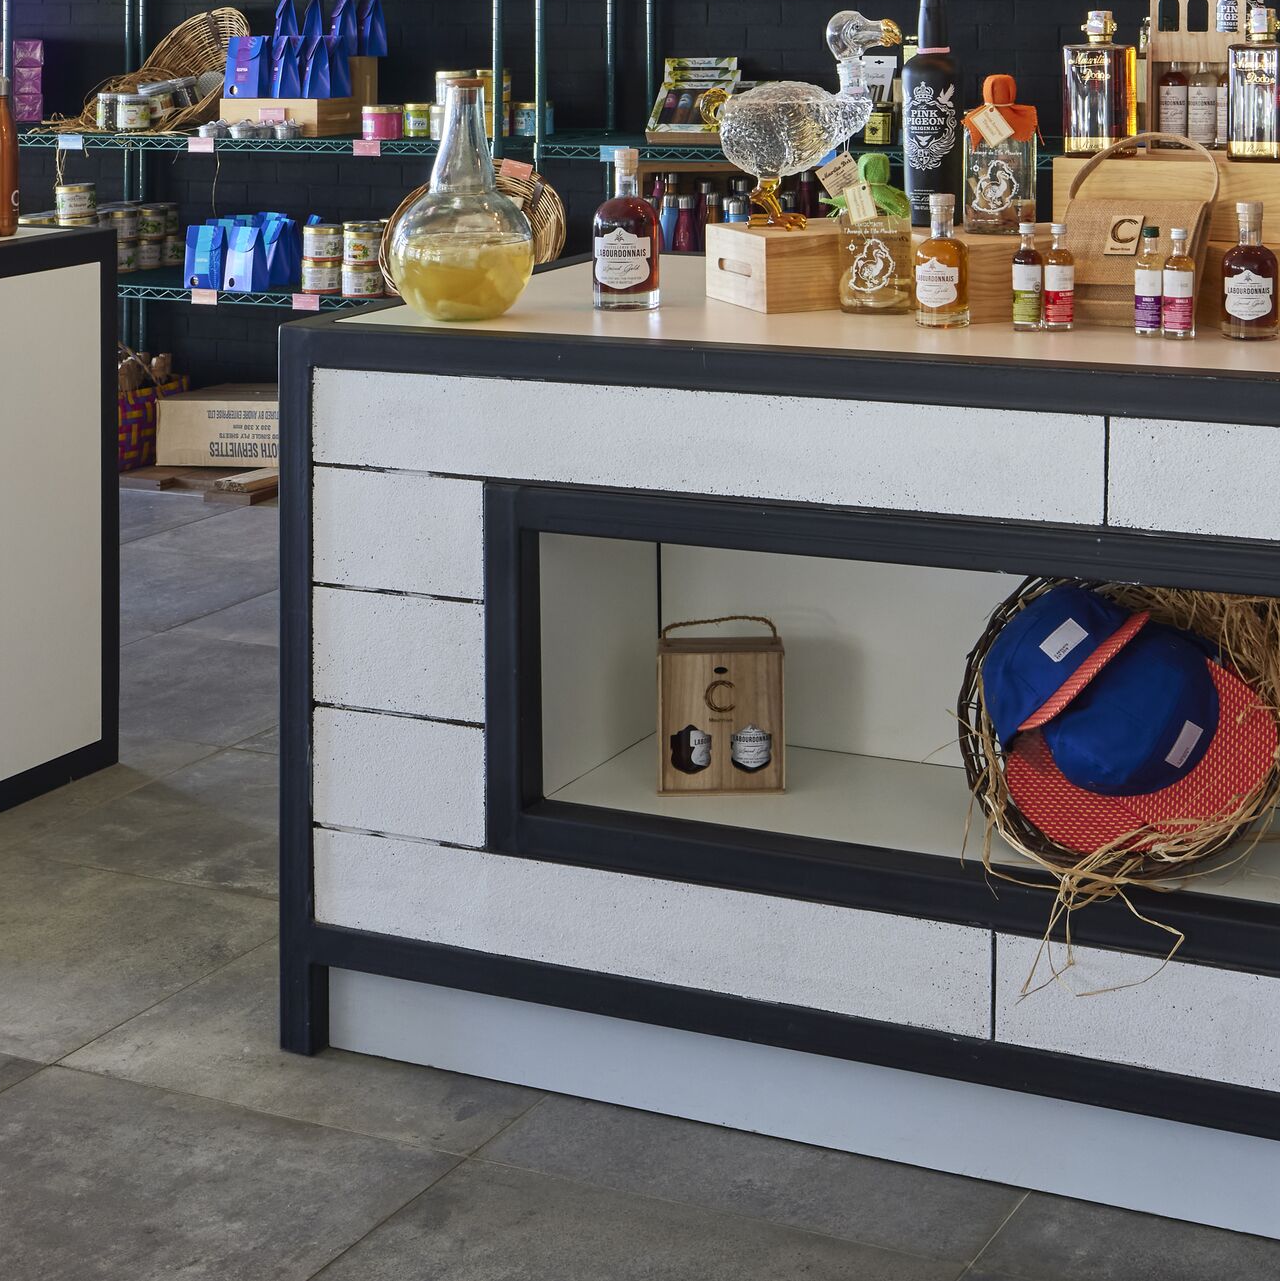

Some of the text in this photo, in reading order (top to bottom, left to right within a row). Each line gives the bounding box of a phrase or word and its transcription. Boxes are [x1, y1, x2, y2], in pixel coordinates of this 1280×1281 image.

[1084, 68, 1107, 80] Dodo
[1245, 72, 1270, 83] Dodo
[910, 109, 938, 118] PINK
[906, 117, 945, 126] PIGEON
[1110, 218, 1139, 244] C
[597, 248, 647, 258] LABOURDONNAIS
[623, 263, 641, 274] Gold
[216, 409, 242, 420] ENTERPRISE
[242, 410, 257, 420] ANDRE
[258, 410, 265, 419] BY
[209, 441, 258, 458] SERVIETTES
[705, 680, 736, 713] C
